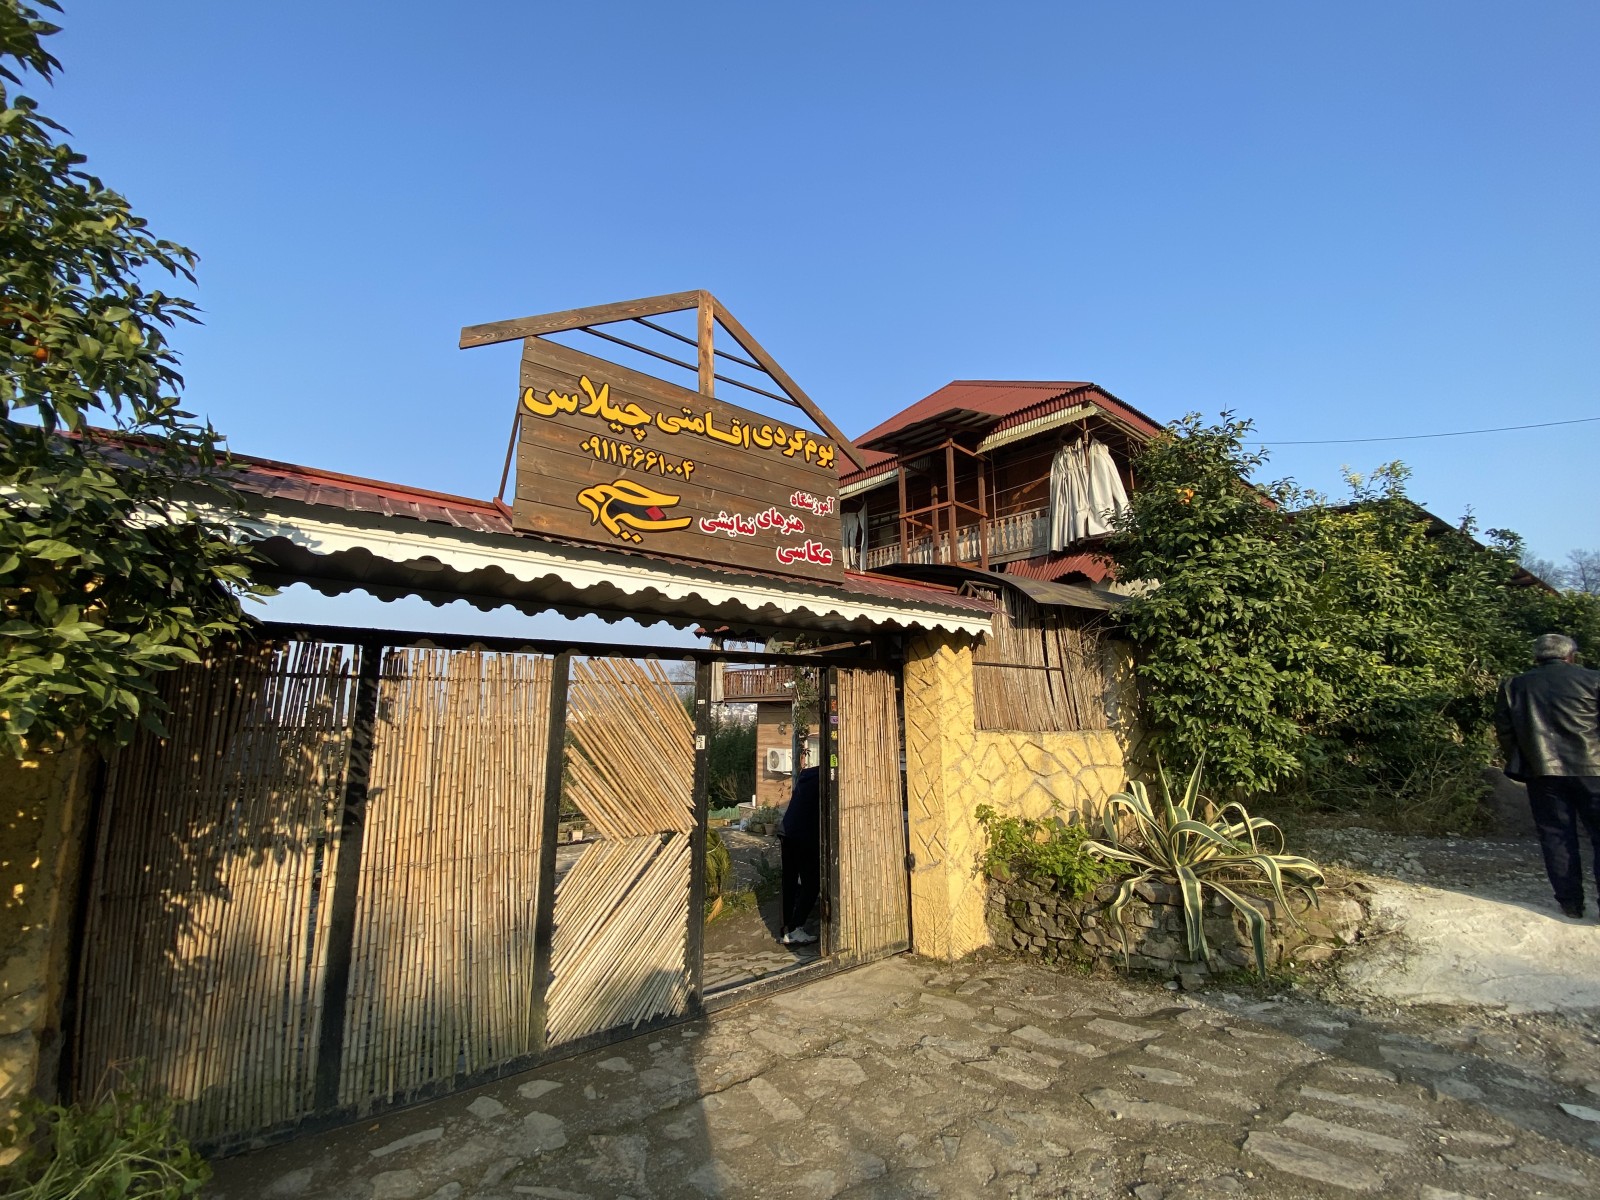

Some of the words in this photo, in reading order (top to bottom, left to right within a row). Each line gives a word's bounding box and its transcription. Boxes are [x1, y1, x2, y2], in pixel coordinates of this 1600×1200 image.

[522, 375, 652, 441] چیلاس
[656, 407, 750, 449] اقامتی
[790, 491, 835, 516] آموزشگاه
[699, 511, 756, 537] نمایشی
[756, 507, 805, 535] هنرهای
[777, 539, 832, 565] عکاسی
